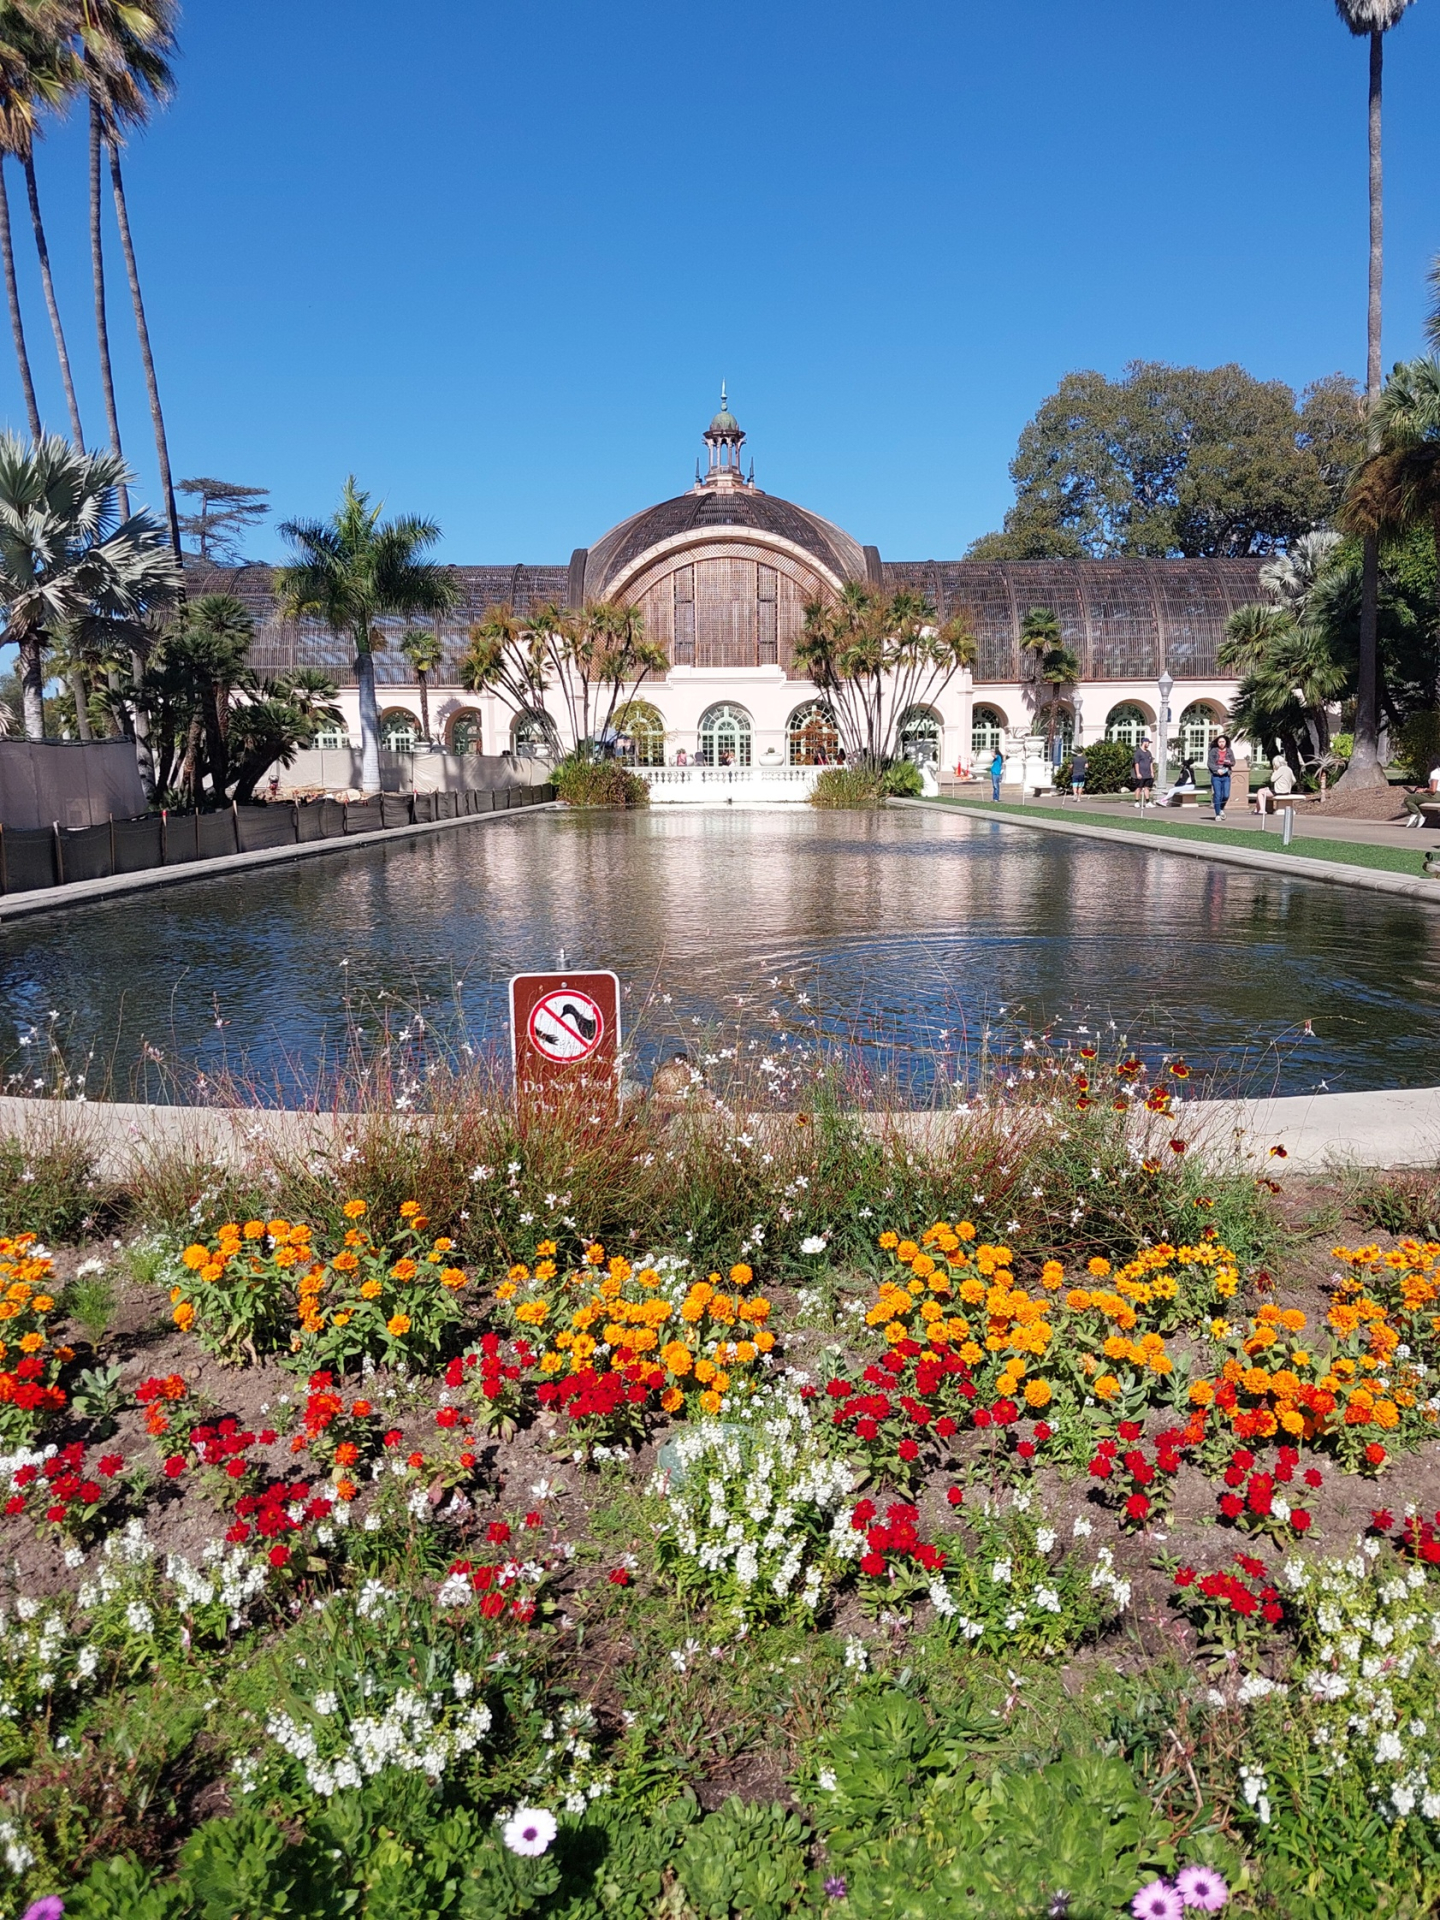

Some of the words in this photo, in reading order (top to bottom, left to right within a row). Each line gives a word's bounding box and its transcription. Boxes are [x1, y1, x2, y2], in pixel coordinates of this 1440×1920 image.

[523, 1080, 544, 1093] Do
[550, 1079, 574, 1091] Not
[580, 1077, 612, 1090] Feed
